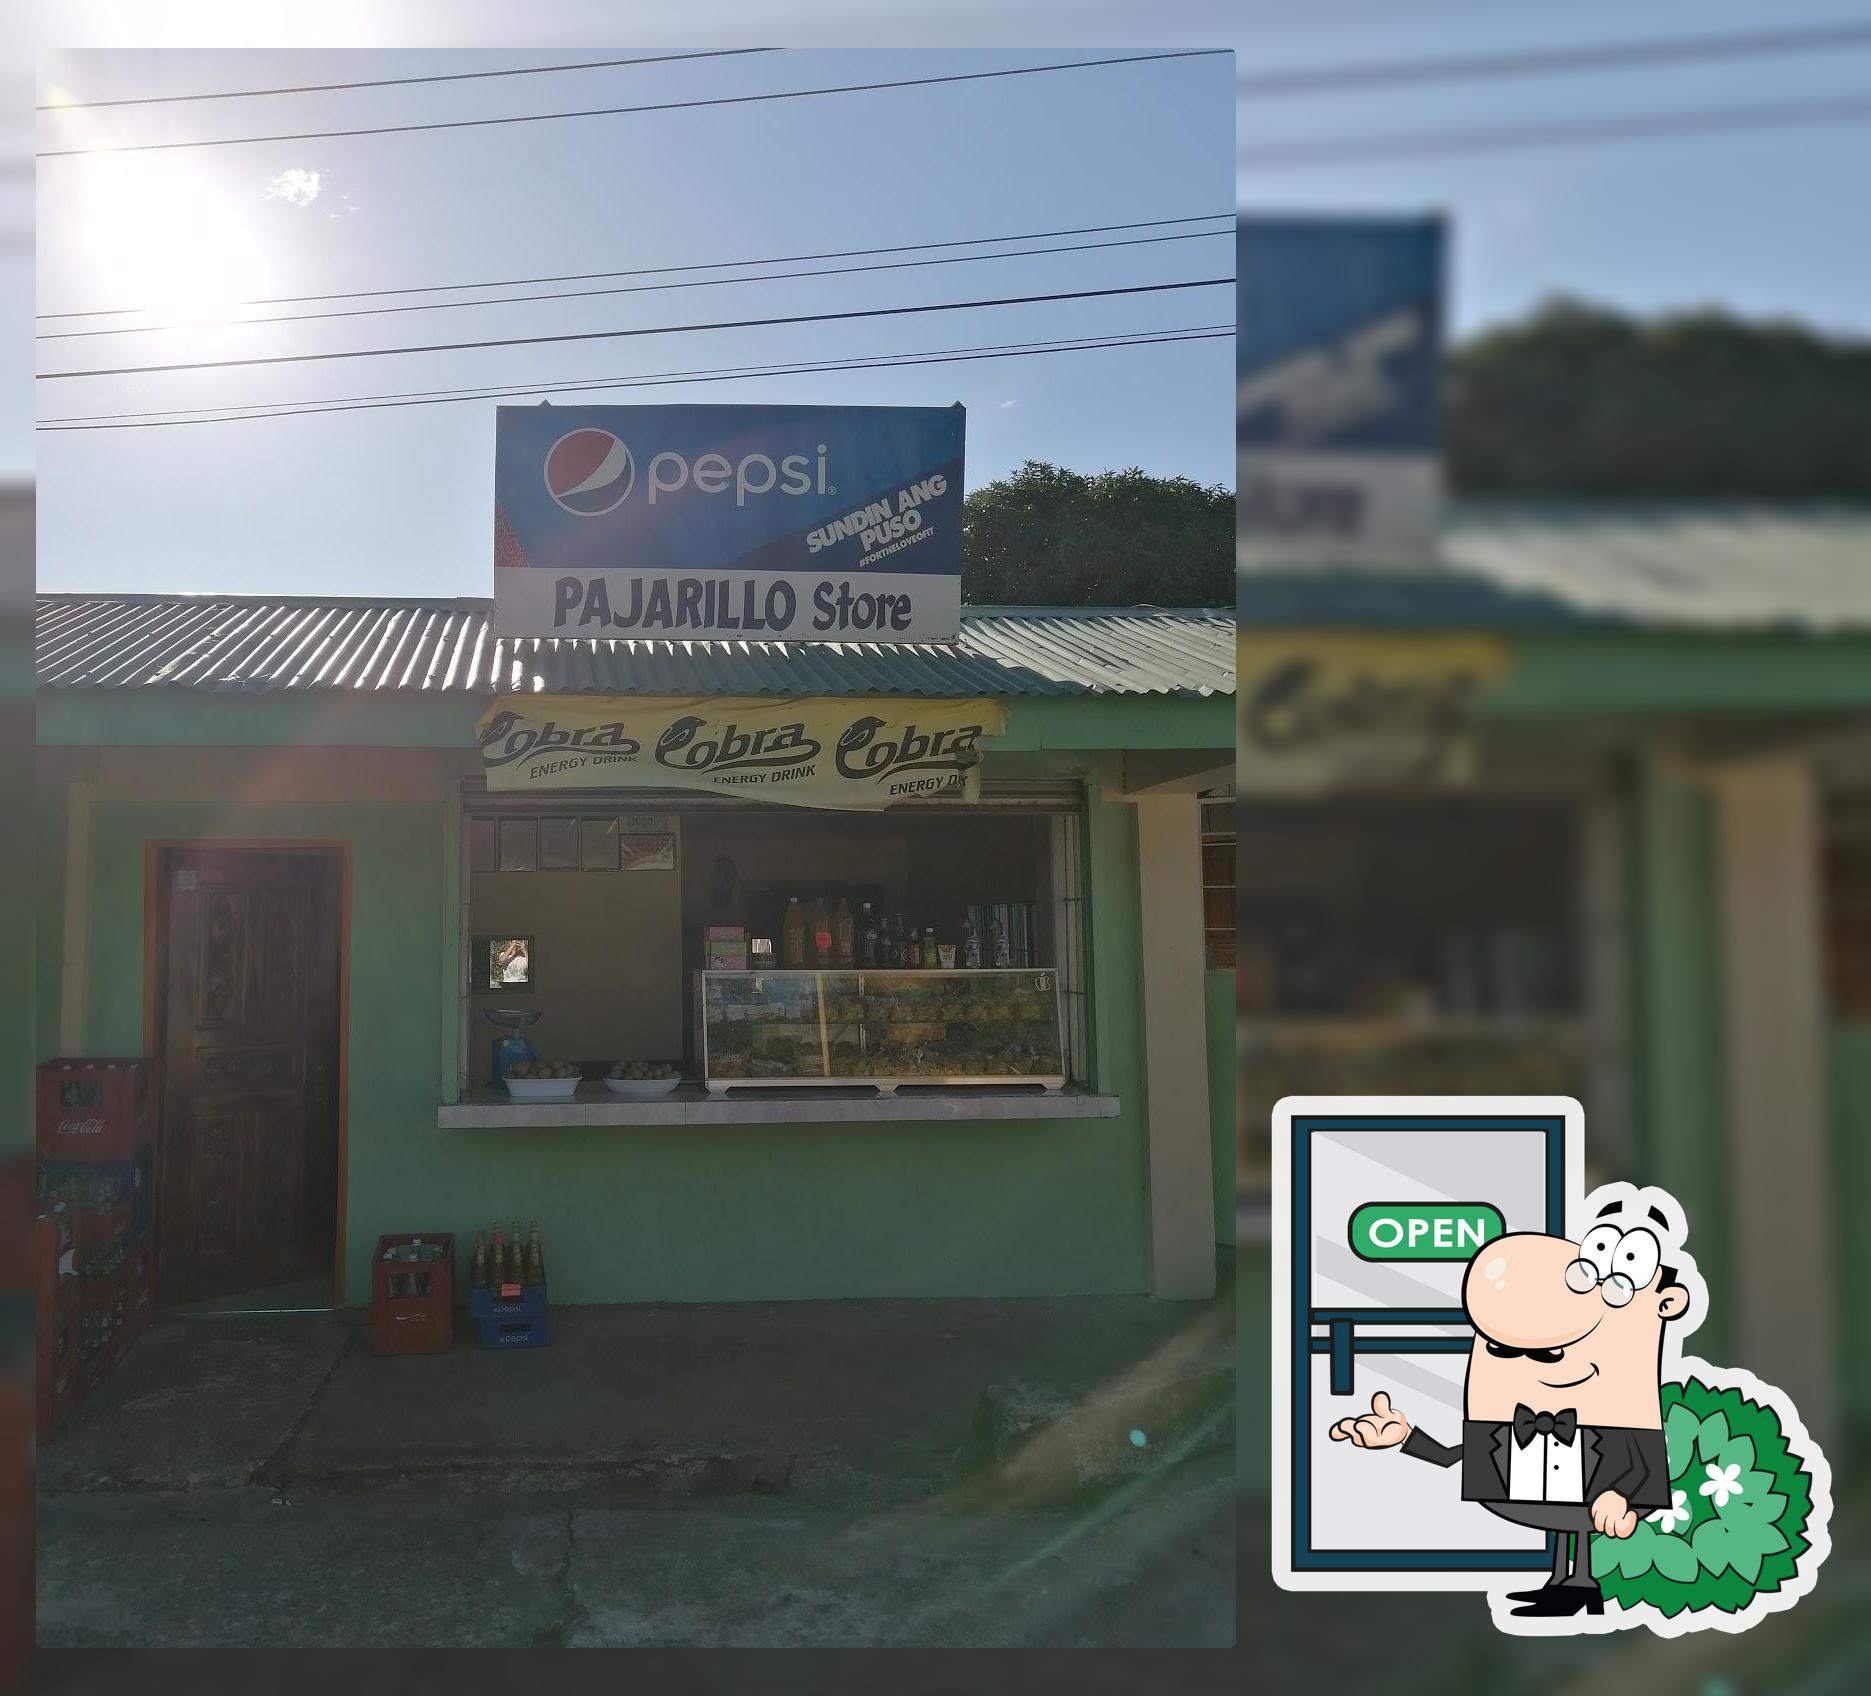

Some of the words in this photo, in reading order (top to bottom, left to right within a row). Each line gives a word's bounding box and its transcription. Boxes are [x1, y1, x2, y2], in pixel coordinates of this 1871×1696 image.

[649, 443, 827, 507] pepsi
[807, 498, 893, 553] SUNDIN
[898, 474, 947, 513] ANG
[859, 509, 922, 552] PUSO
[859, 526, 934, 567] #FORTHELOVEOFIT
[553, 576, 796, 631] PAJARILLO
[813, 581, 912, 630] Store
[480, 711, 640, 768] Cobra
[655, 715, 821, 774] Cobra
[835, 715, 983, 782] Cobra
[530, 757, 588, 779] ENERGY
[593, 756, 639, 765] DRINK
[714, 773, 767, 785] ENERGY
[771, 765, 816, 783] DRINK
[890, 777, 944, 796] ENERGY
